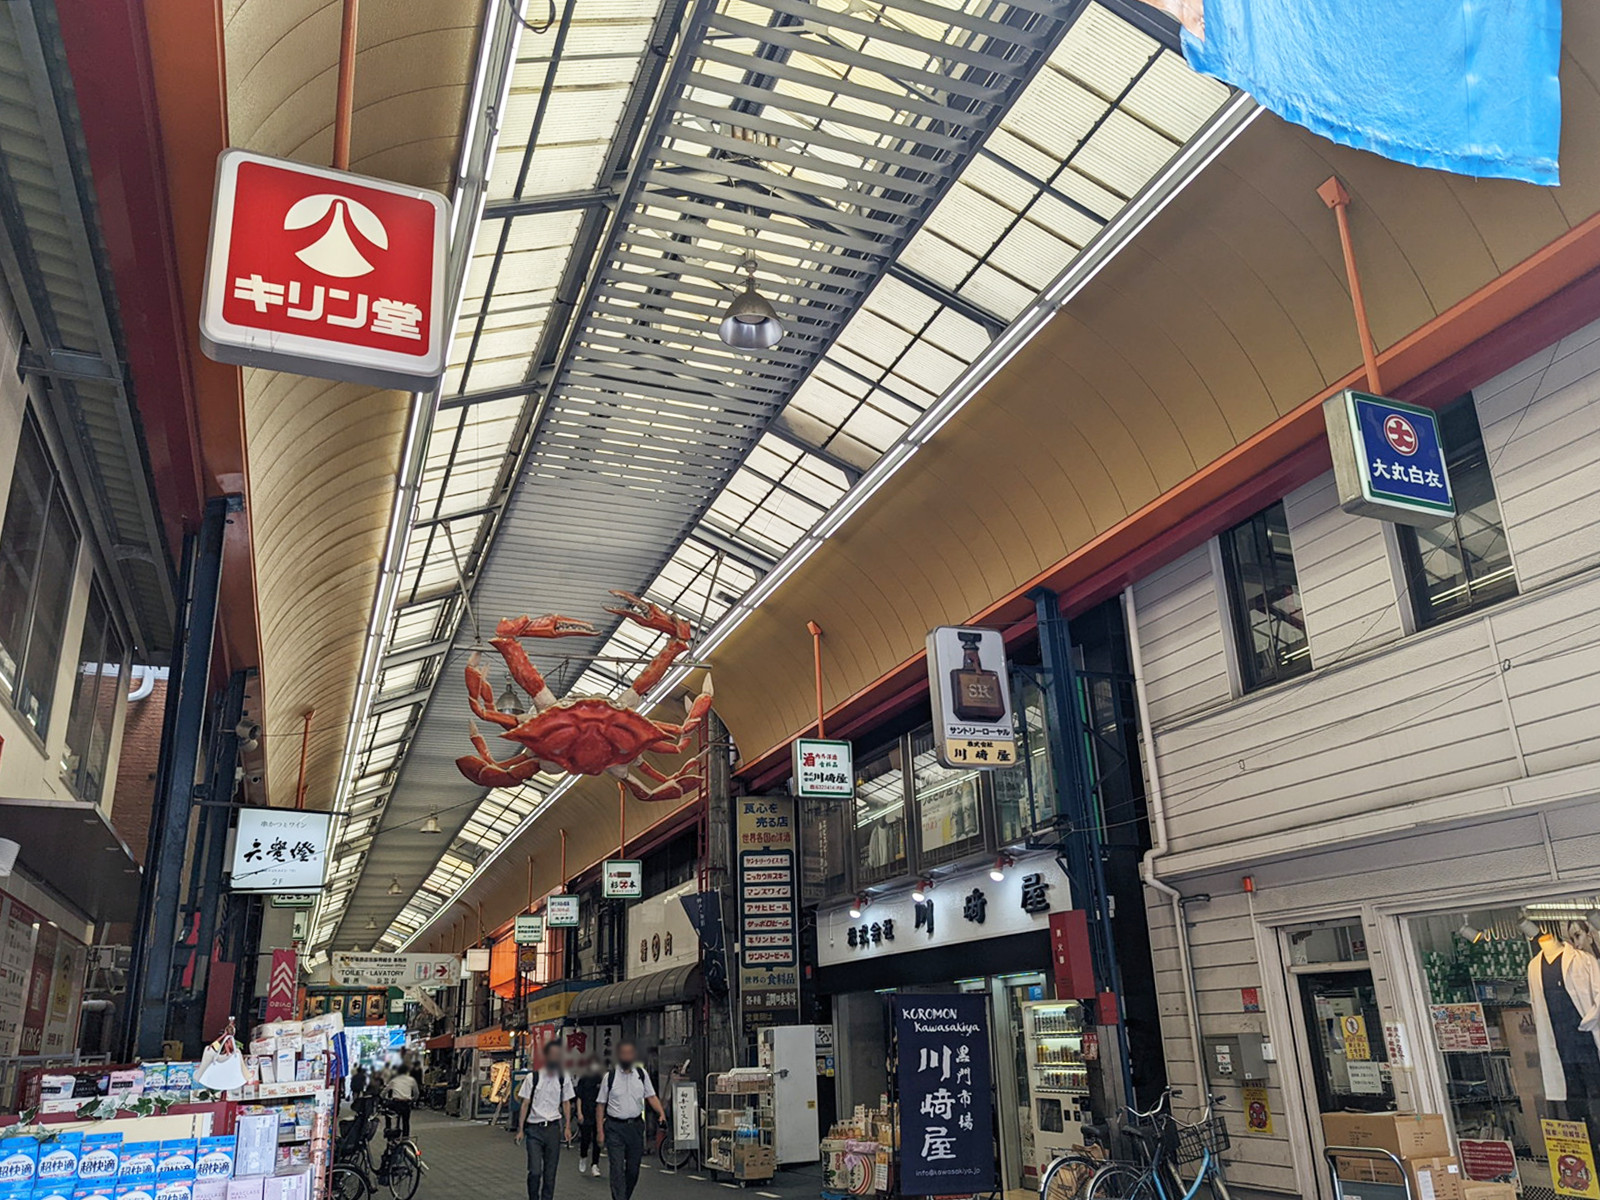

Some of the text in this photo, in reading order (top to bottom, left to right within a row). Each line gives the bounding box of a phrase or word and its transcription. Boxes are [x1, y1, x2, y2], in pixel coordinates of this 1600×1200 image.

[234, 273, 423, 341] キリン堂
[1372, 458, 1443, 488] 大丸白衣
[949, 726, 1011, 737] サントリーローヤル
[803, 752, 815, 767] 酒
[743, 803, 778, 814] 良心を
[260, 820, 307, 829] 串かつとワイン
[756, 816, 788, 828] 売る店
[742, 832, 791, 844] 世界各国の洋酒
[746, 887, 788, 896] マンズワイン
[746, 903, 789, 912] アサヒビール
[747, 919, 789, 928] サッポロビール
[747, 935, 790, 944] キリンビール
[847, 918, 895, 947] 株式会社
[1056, 929, 1065, 965] 消火器
[748, 951, 790, 960] サントリービール
[745, 992, 797, 1007] 各種 調味料
[914, 1021, 980, 1037] Kawasakiya
[566, 1029, 588, 1054] 肉
[955, 1044, 974, 1132] 黒門市場
[40, 1159, 75, 1173] 超快適
[79, 1159, 116, 1174] 超快適
[198, 1162, 230, 1176] 超快適
[915, 1167, 981, 1177] info@kawasakiya.jp
